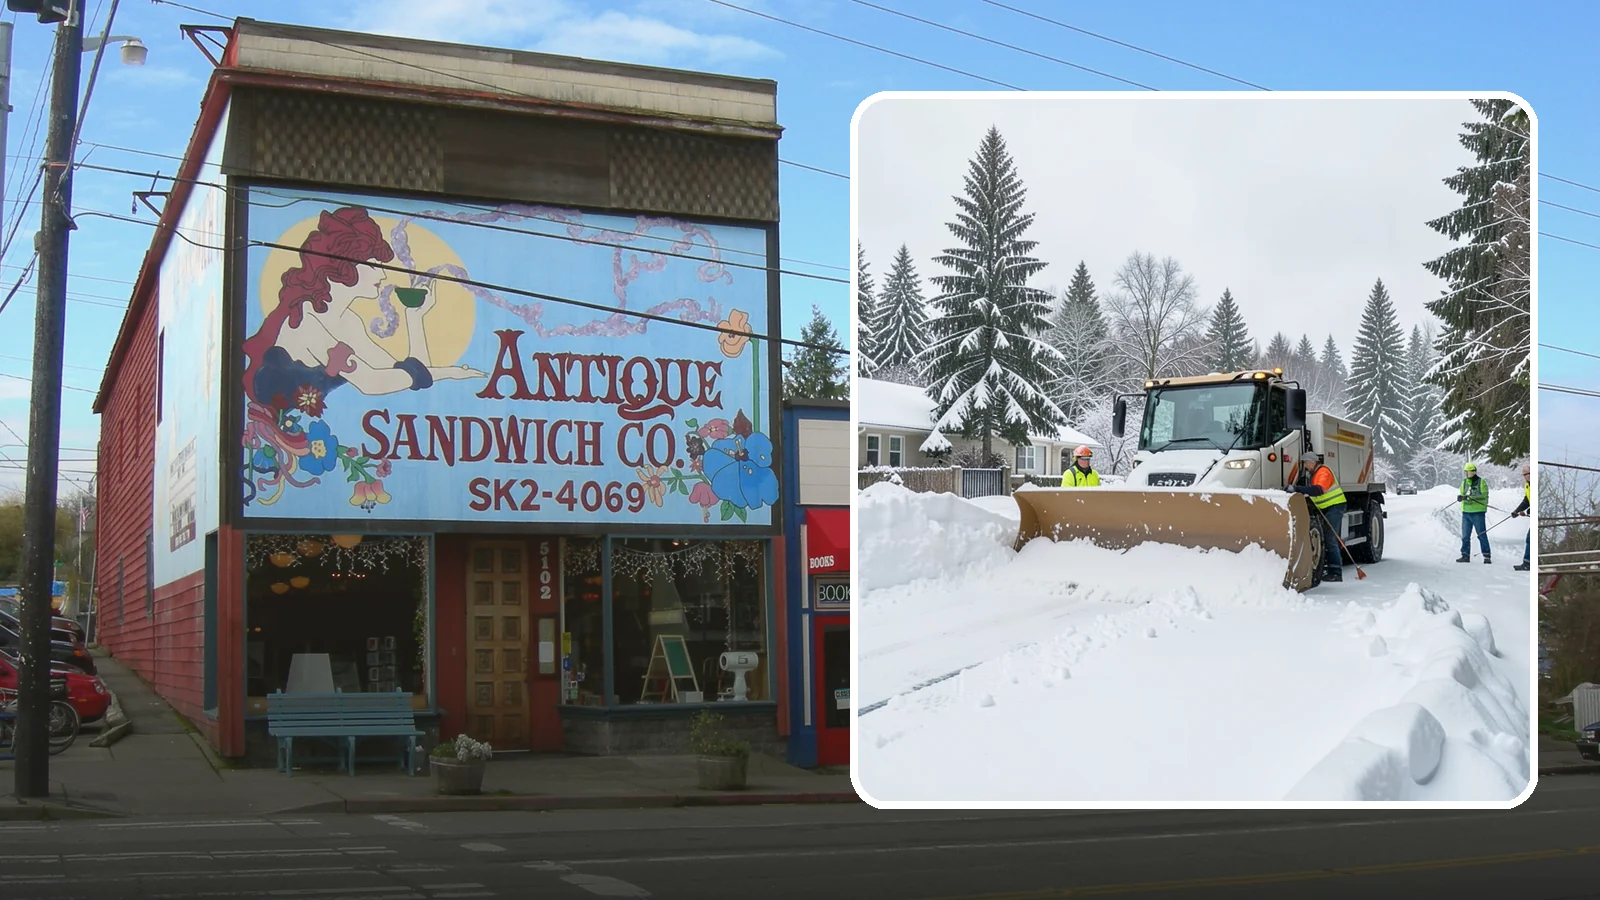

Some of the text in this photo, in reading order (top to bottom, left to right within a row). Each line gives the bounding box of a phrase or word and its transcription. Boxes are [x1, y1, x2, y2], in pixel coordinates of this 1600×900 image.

[476, 328, 723, 421] ANTIQUE
[361, 408, 685, 469] SANDWICH CO.
[468, 476, 646, 513] SK2-4069
[539, 541, 552, 600] 5102
[809, 554, 836, 569] BOOKS
